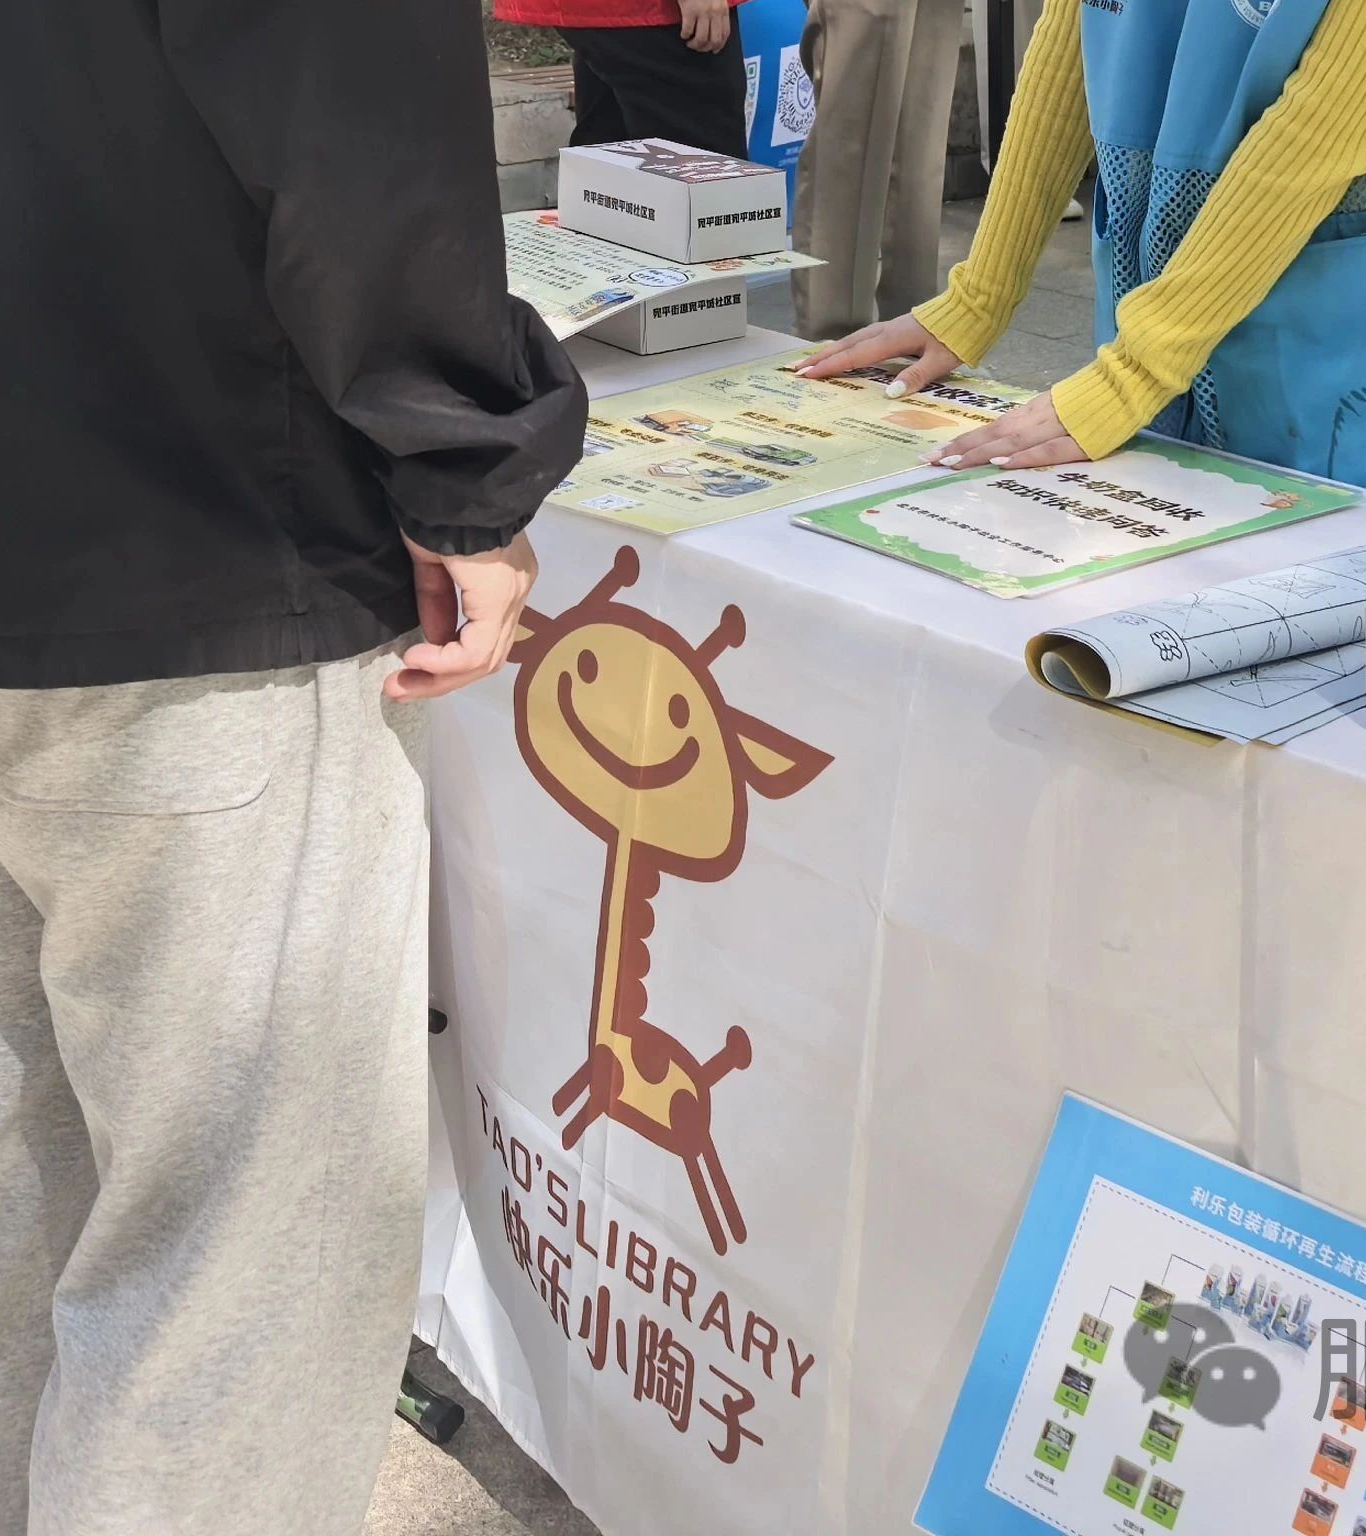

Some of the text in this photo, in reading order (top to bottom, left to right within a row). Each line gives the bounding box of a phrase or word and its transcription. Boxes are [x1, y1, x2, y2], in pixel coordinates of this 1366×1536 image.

[986, 478, 1169, 538] 知识快速问答
[1056, 472, 1206, 522] 牛奶盒回收
[475, 1083, 816, 1400] TAO'S LIBRARY
[501, 1185, 764, 1465] 快乐小陶子
